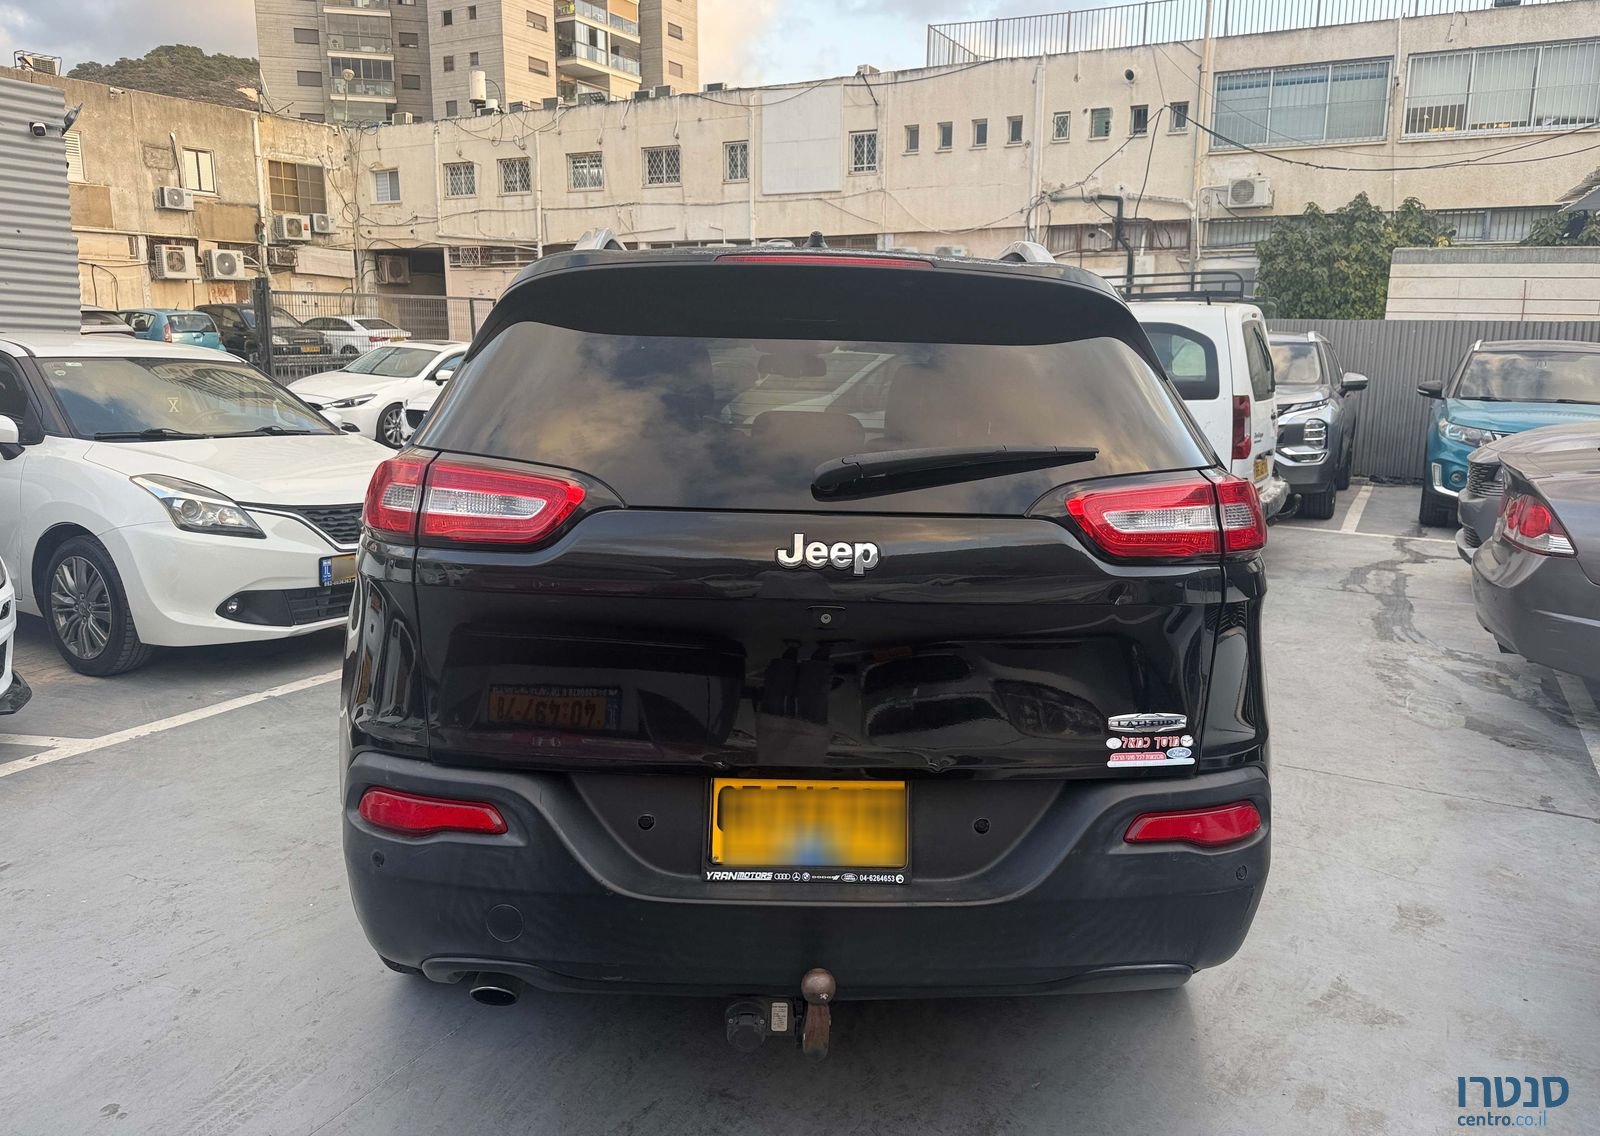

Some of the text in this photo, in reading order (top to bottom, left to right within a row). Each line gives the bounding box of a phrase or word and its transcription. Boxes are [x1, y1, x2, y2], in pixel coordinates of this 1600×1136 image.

[776, 532, 881, 577] Jeep
[324, 565, 331, 575] IL
[1121, 735, 1180, 749] מוסך כמאל
